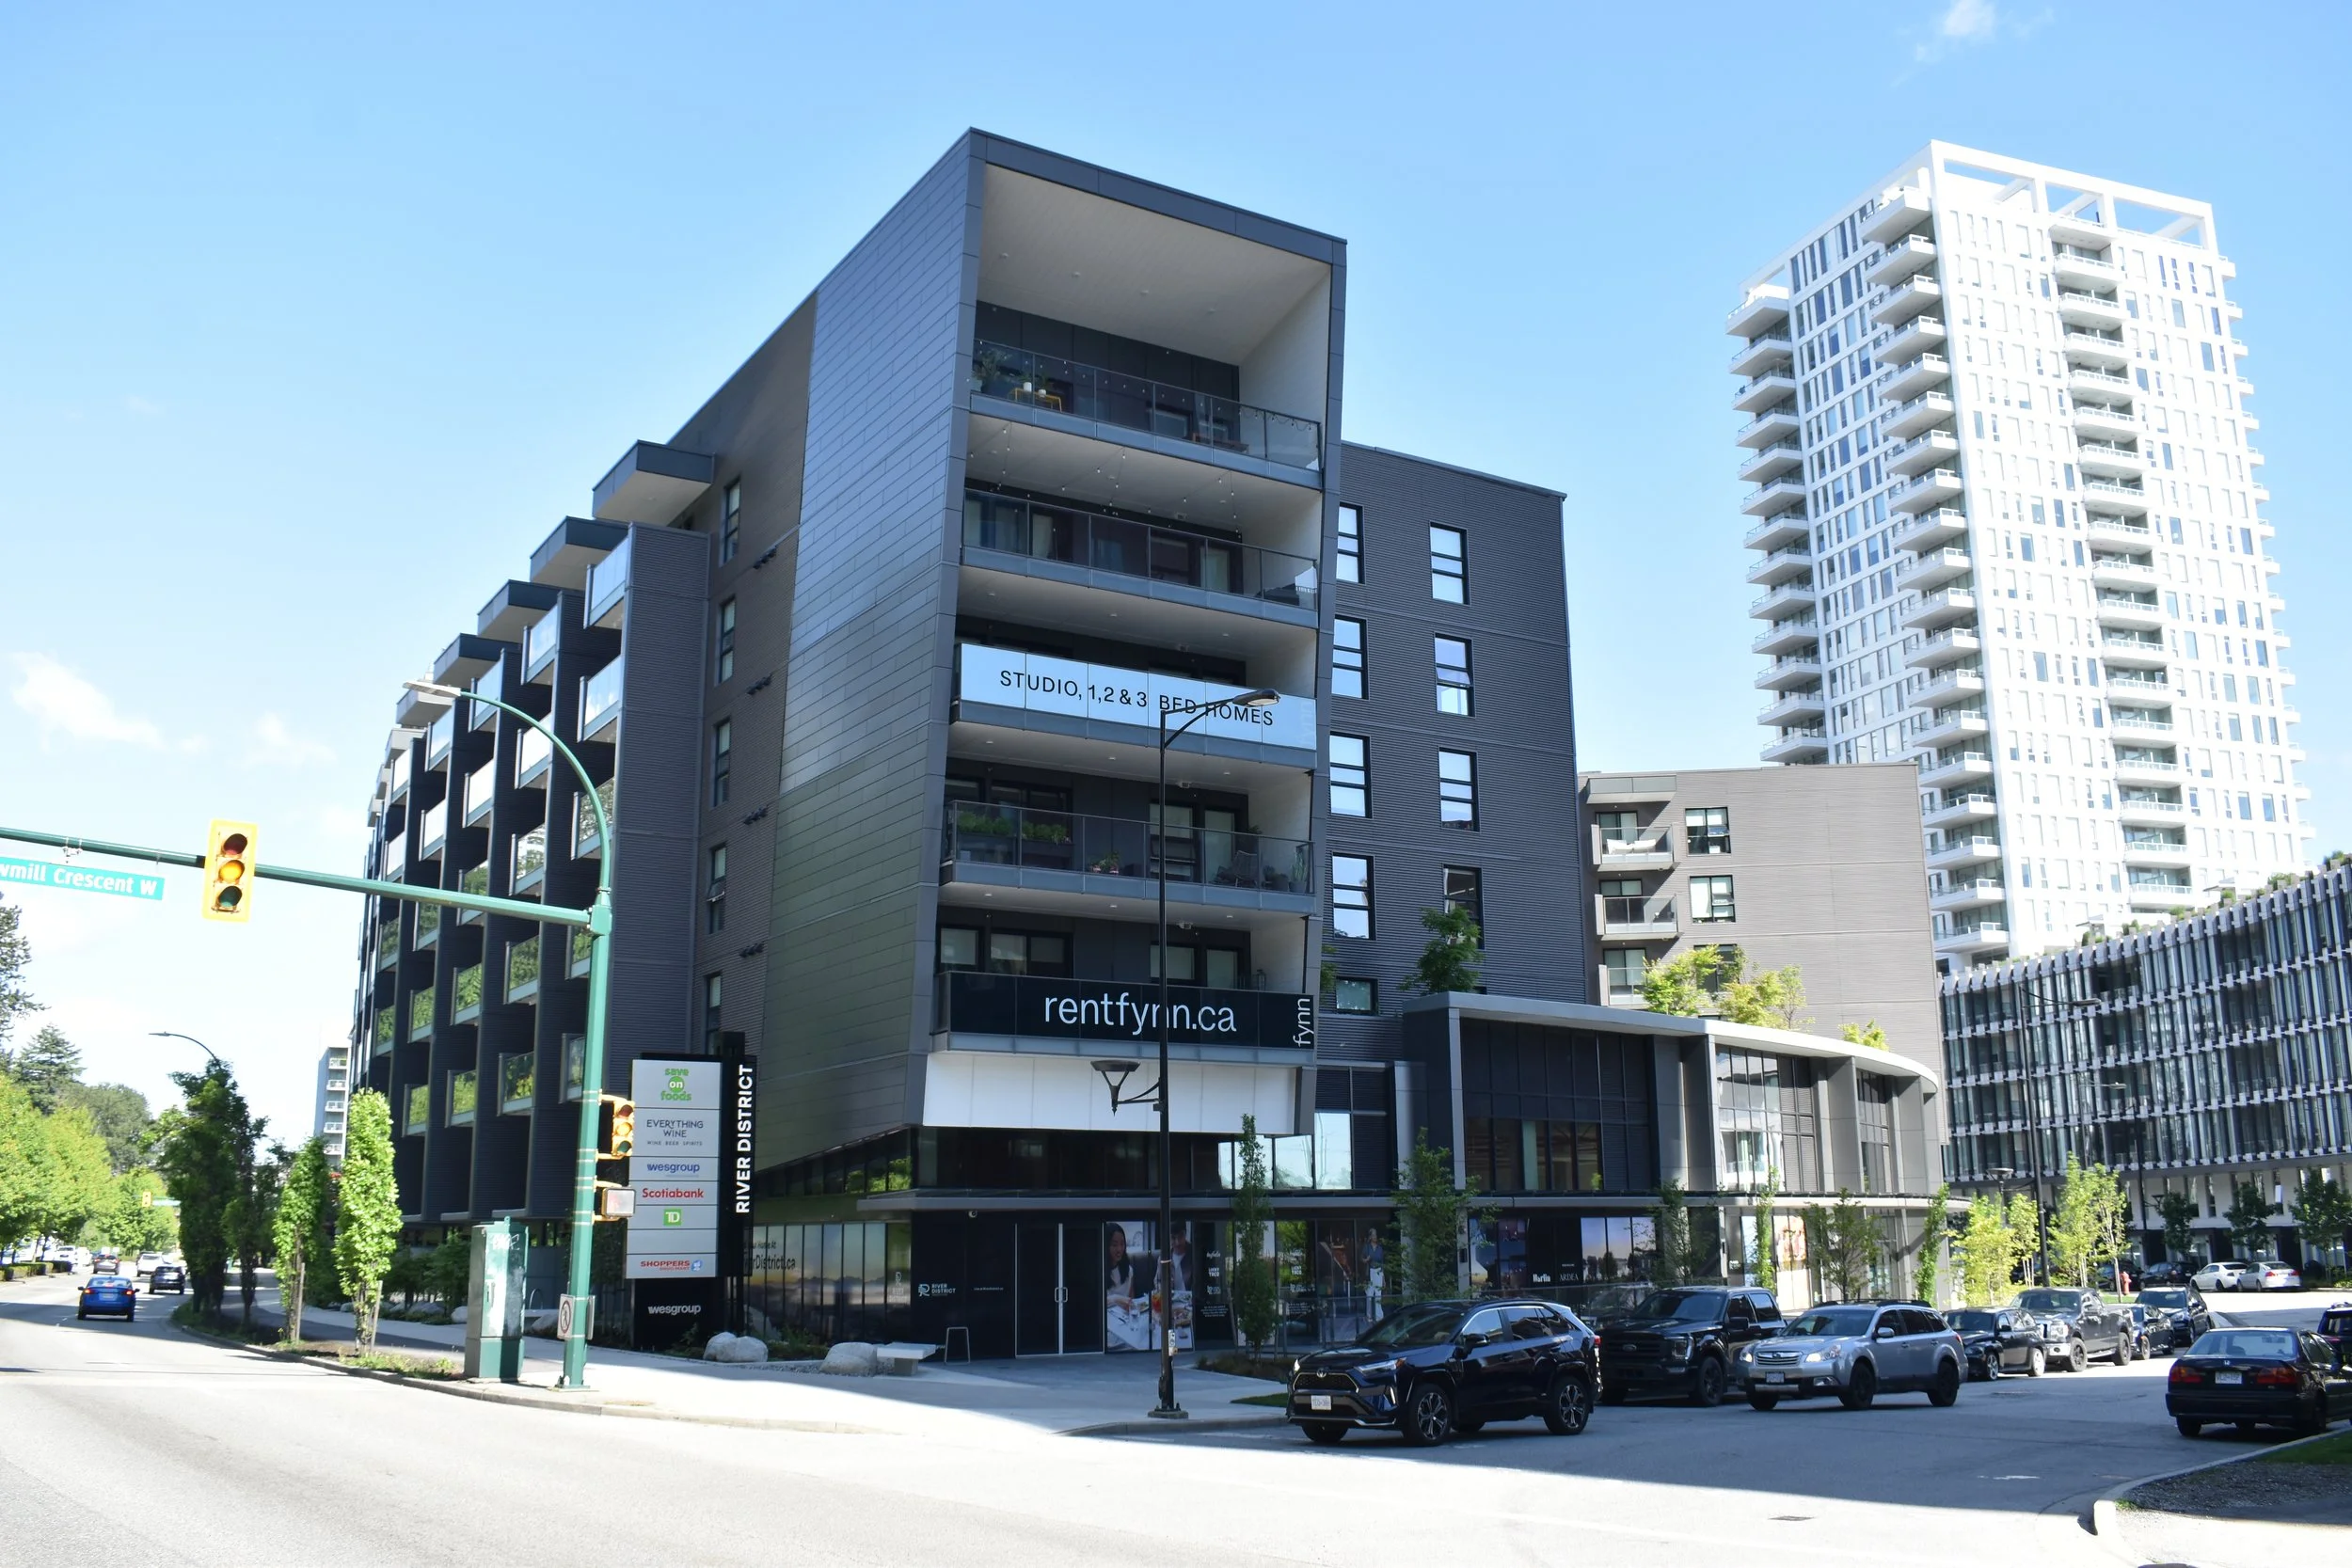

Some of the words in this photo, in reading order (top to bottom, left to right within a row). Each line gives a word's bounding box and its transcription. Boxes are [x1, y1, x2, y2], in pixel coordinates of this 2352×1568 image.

[1159, 694, 1197, 714] BED
[1205, 702, 1273, 725] HOMES
[53, 868, 134, 893] Crescent
[139, 879, 158, 896] W
[1044, 991, 1237, 1036] rentfynn.ca
[1293, 998, 1314, 1047] fynn
[664, 1069, 690, 1077] save
[669, 1081, 683, 1089] on
[660, 1091, 692, 1101] foods
[737, 1064, 754, 1152] DISTRICT
[646, 1119, 704, 1130] EVERYTHING
[662, 1129, 687, 1138] WINE
[646, 1163, 701, 1173] wesgroup
[735, 1157, 751, 1213] RIVER
[642, 1188, 705, 1198] Scotiabank
[664, 1211, 680, 1223] TD
[647, 1304, 701, 1315] wesgroup
